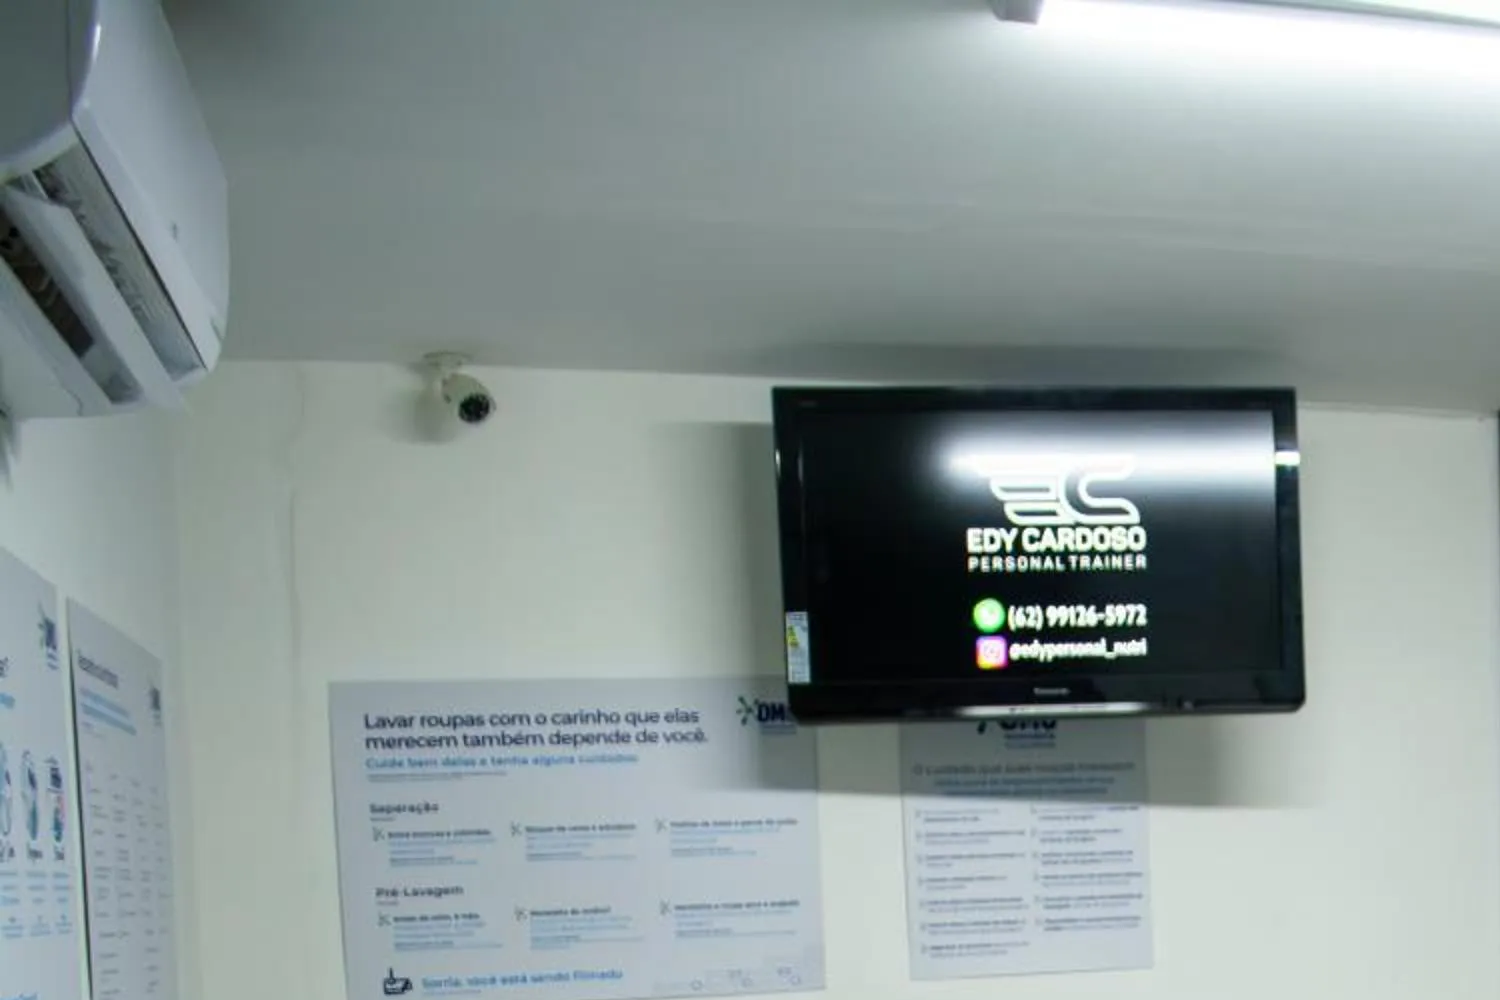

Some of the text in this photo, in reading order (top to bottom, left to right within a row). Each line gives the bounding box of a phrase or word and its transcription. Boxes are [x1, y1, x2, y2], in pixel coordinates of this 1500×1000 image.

[966, 525, 1147, 552] EDY CARDOSO
[967, 554, 1147, 572] PERSONAL TRAINER
[1007, 603, 1148, 631] (62) 99126-5972
[364, 708, 700, 730] Lavar roupas com o carinho que elas
[756, 702, 787, 722] OM
[364, 728, 708, 750] merecem também depende de você.
[407, 755, 438, 768] bem
[369, 802, 440, 815] Separação
